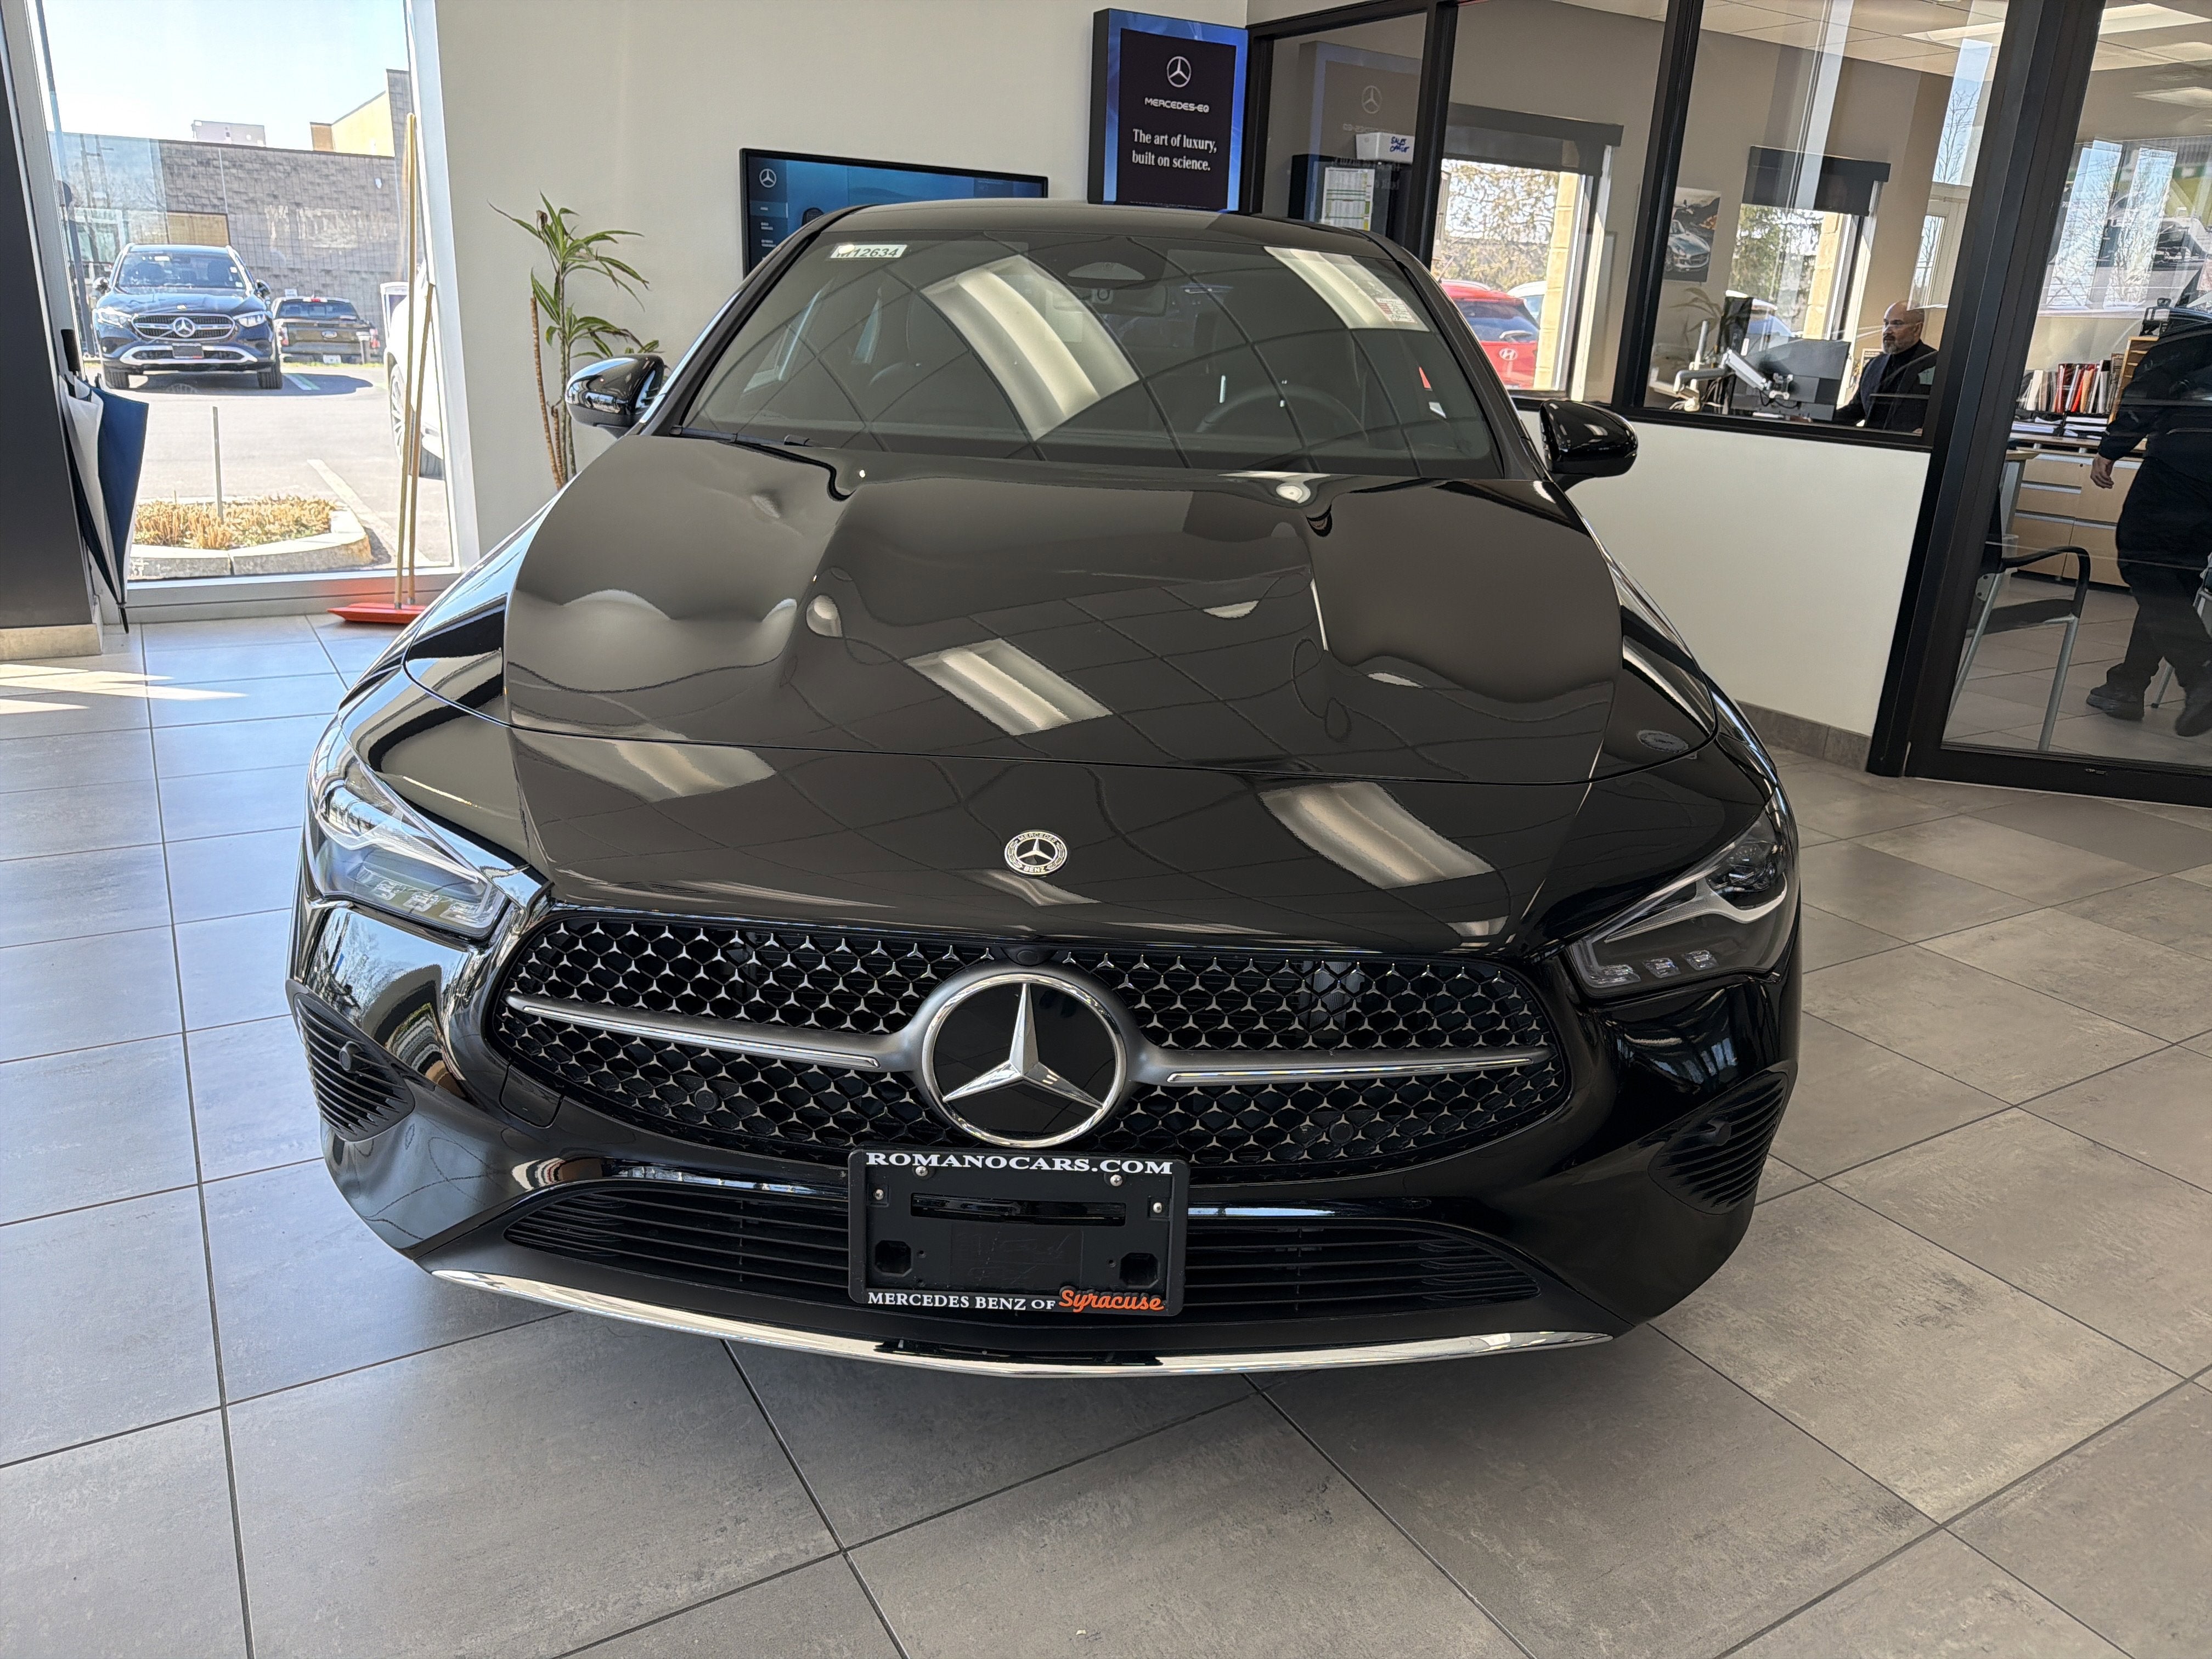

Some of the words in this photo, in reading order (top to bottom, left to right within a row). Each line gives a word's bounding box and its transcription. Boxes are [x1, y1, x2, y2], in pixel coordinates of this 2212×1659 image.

[1144, 97, 1210, 113] MERCEDES-EQ
[1132, 128, 1152, 144] The
[1154, 134, 1169, 146] art
[1170, 134, 1182, 147] of
[1183, 134, 1217, 154] luxury,
[1132, 149, 1155, 166] built
[1157, 156, 1170, 167] on
[1172, 155, 1211, 171] science.
[1018, 833, 1057, 843] MERCEDES
[866, 1152, 1173, 1175] ROMANOCARS.COM
[867, 1292, 970, 1308] MERCEDES
[974, 1296, 1026, 1310] BENZ
[1031, 1299, 1056, 1310] OF
[1058, 1289, 1165, 1313] Syracuse
